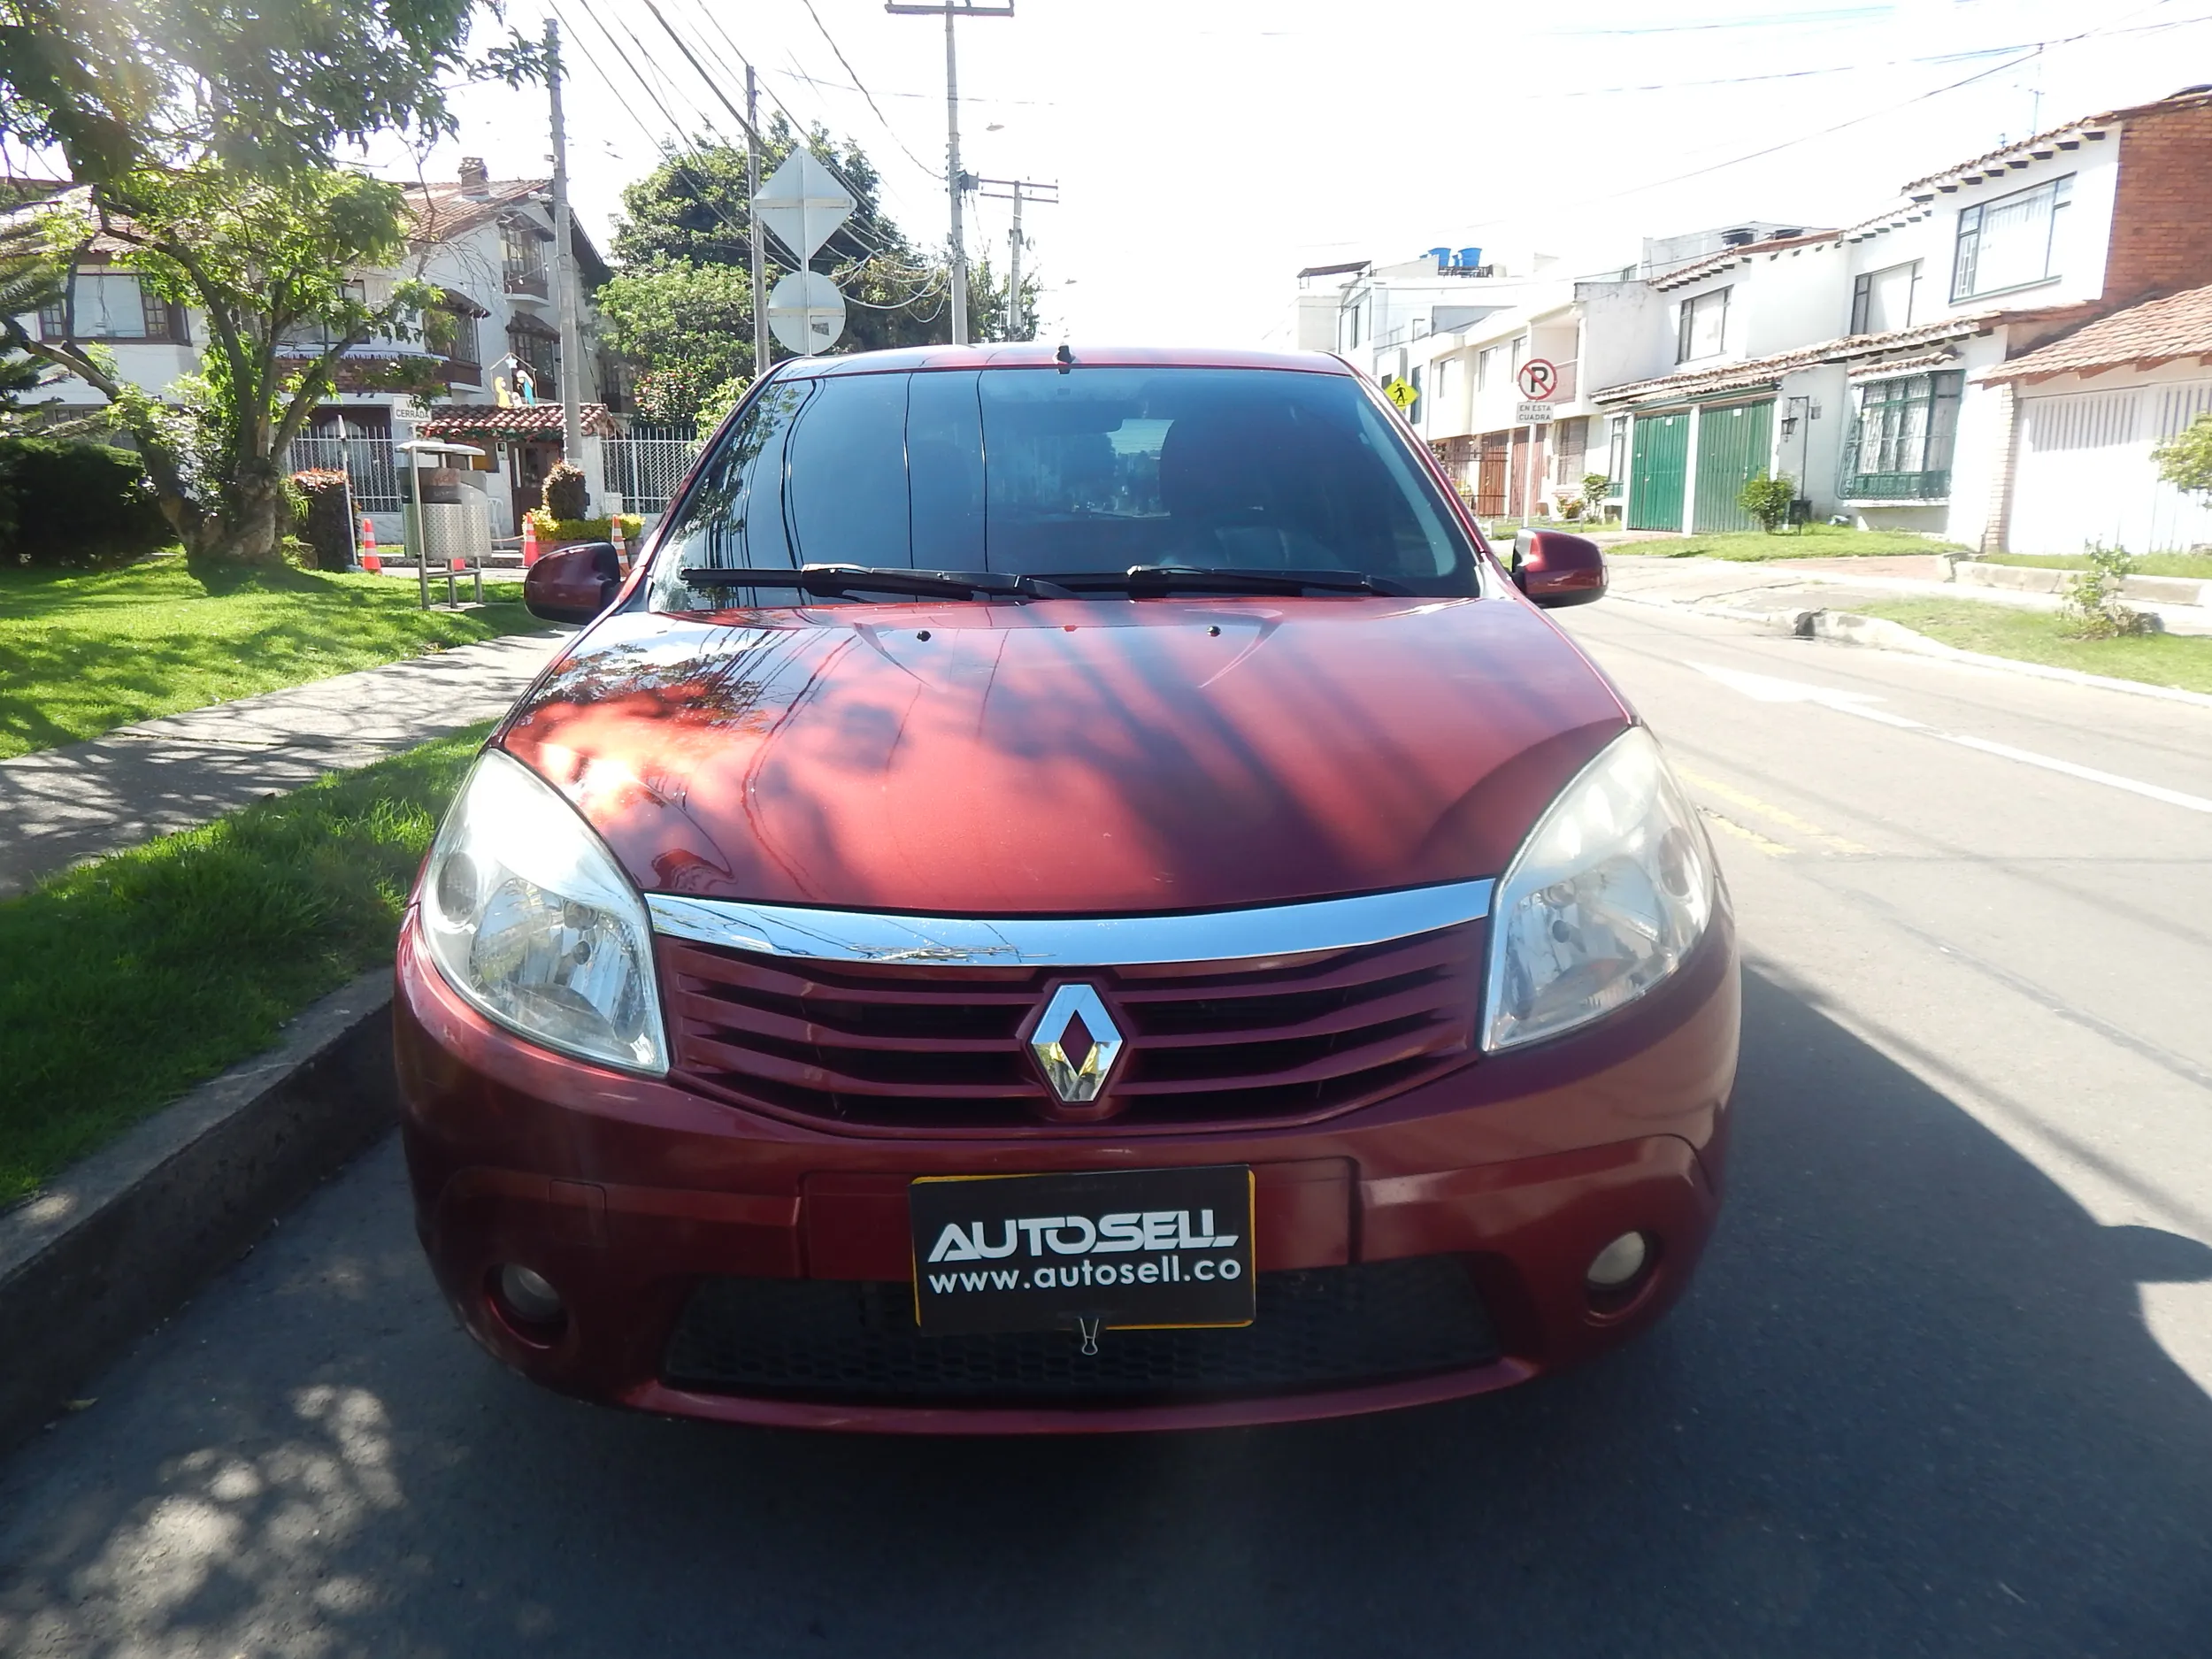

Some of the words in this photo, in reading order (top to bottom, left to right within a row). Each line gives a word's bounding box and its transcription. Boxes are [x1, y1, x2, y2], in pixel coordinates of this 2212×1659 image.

[1531, 366, 1548, 393] P
[927, 1209, 1239, 1263] AUTOSELL
[928, 1255, 1241, 1294] www.autosell.co
